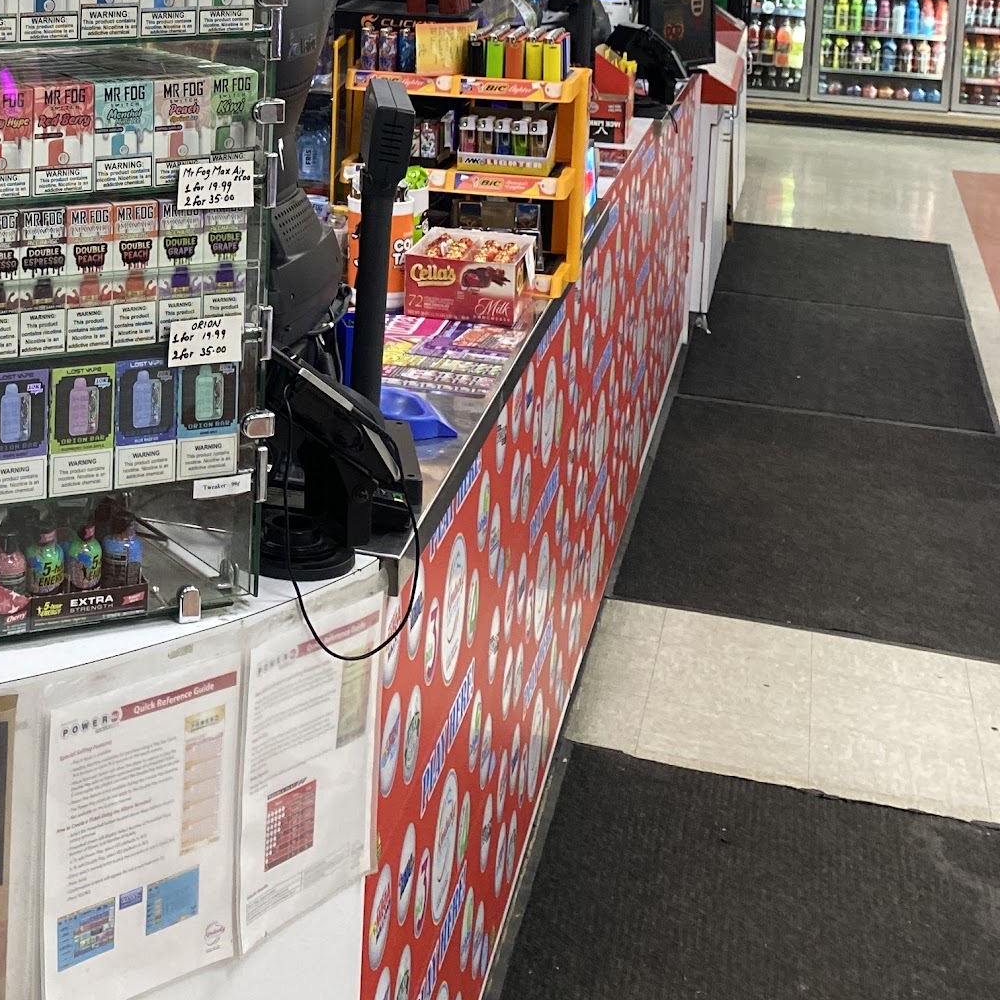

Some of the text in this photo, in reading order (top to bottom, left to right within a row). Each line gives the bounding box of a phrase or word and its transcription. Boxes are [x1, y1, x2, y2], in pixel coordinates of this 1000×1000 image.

[183, 166, 245, 180] Mr Fog Max Air
[185, 184, 191, 193] 1
[193, 182, 204, 192] for
[184, 197, 191, 206] 2
[192, 195, 206, 206] for
[410, 263, 456, 282] Cella's
[408, 294, 423, 307] 72
[475, 298, 511, 315] Milk
[191, 319, 221, 331] ORION
[172, 334, 180, 343] 1
[181, 332, 194, 342] for
[172, 351, 180, 360] 2
[180, 348, 194, 360] for
[134, 682, 214, 714] Quick Reference Guide
